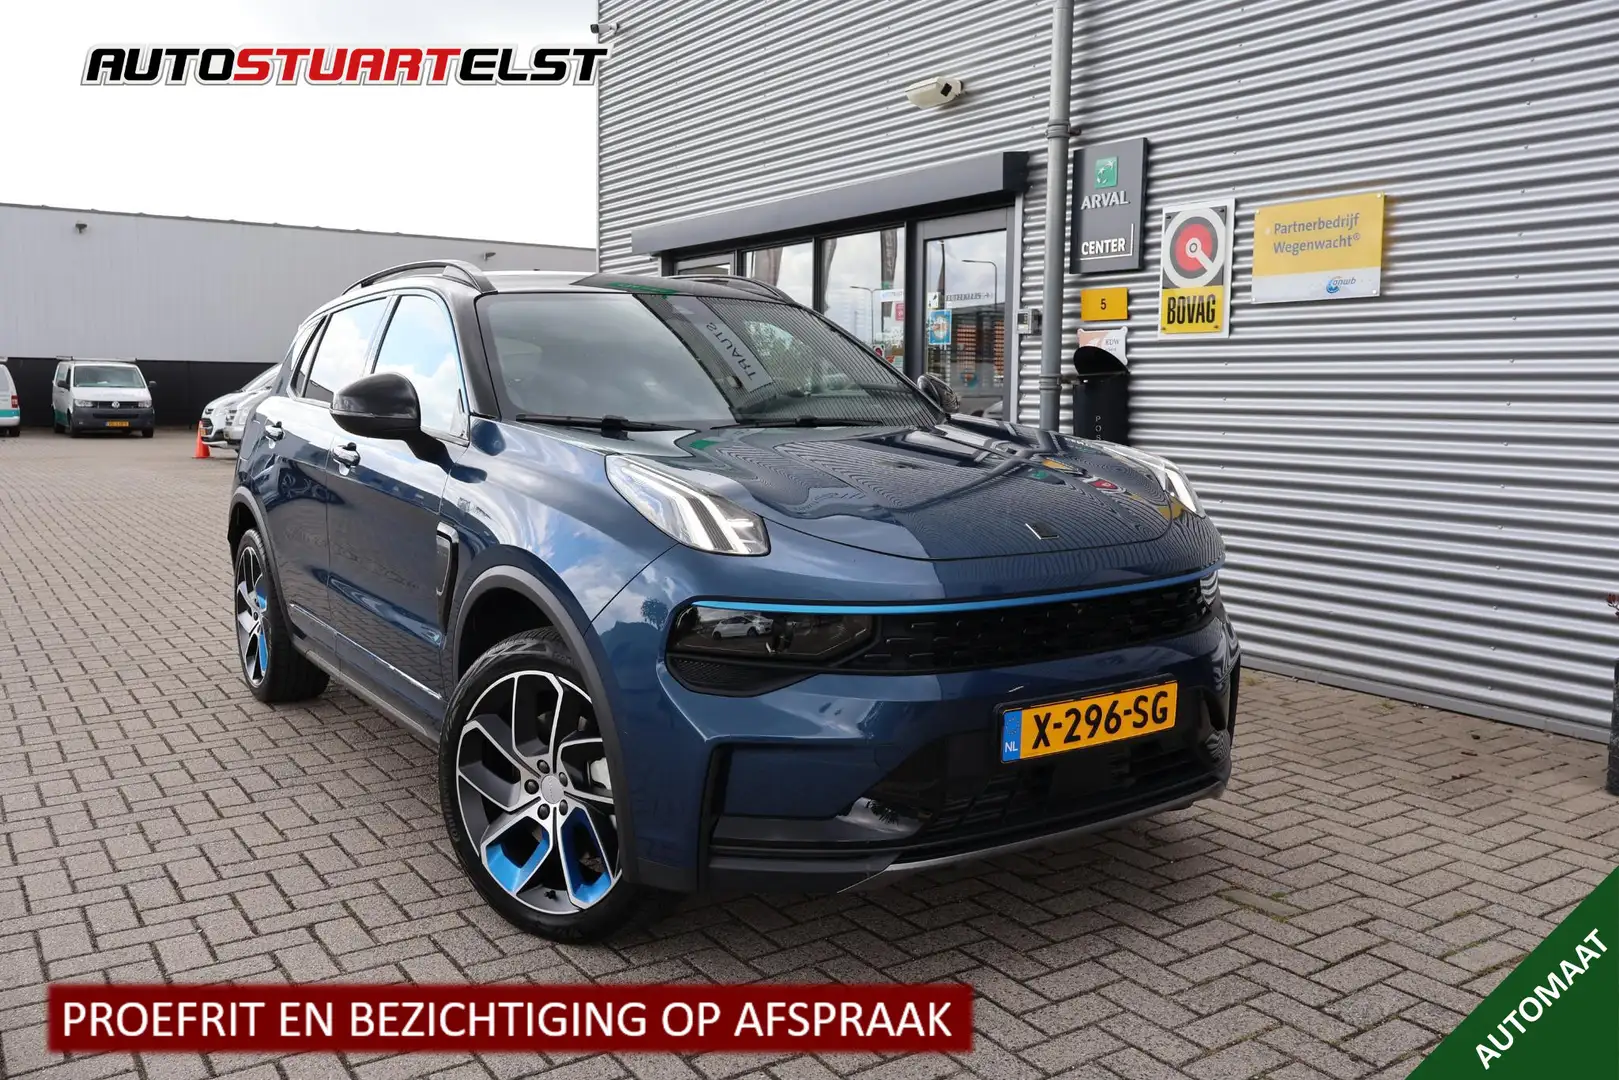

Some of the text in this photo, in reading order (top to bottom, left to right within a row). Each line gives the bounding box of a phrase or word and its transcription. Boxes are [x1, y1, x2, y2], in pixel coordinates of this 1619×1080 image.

[1081, 190, 1130, 210] ARVAL
[1273, 212, 1361, 235] Partnerbedrijf
[1081, 237, 1126, 255] CENTER
[1100, 298, 1108, 311] 5
[1166, 294, 1216, 325] BOVAG
[1031, 690, 1169, 750] X-296-SG
[1004, 741, 1019, 753] NL
